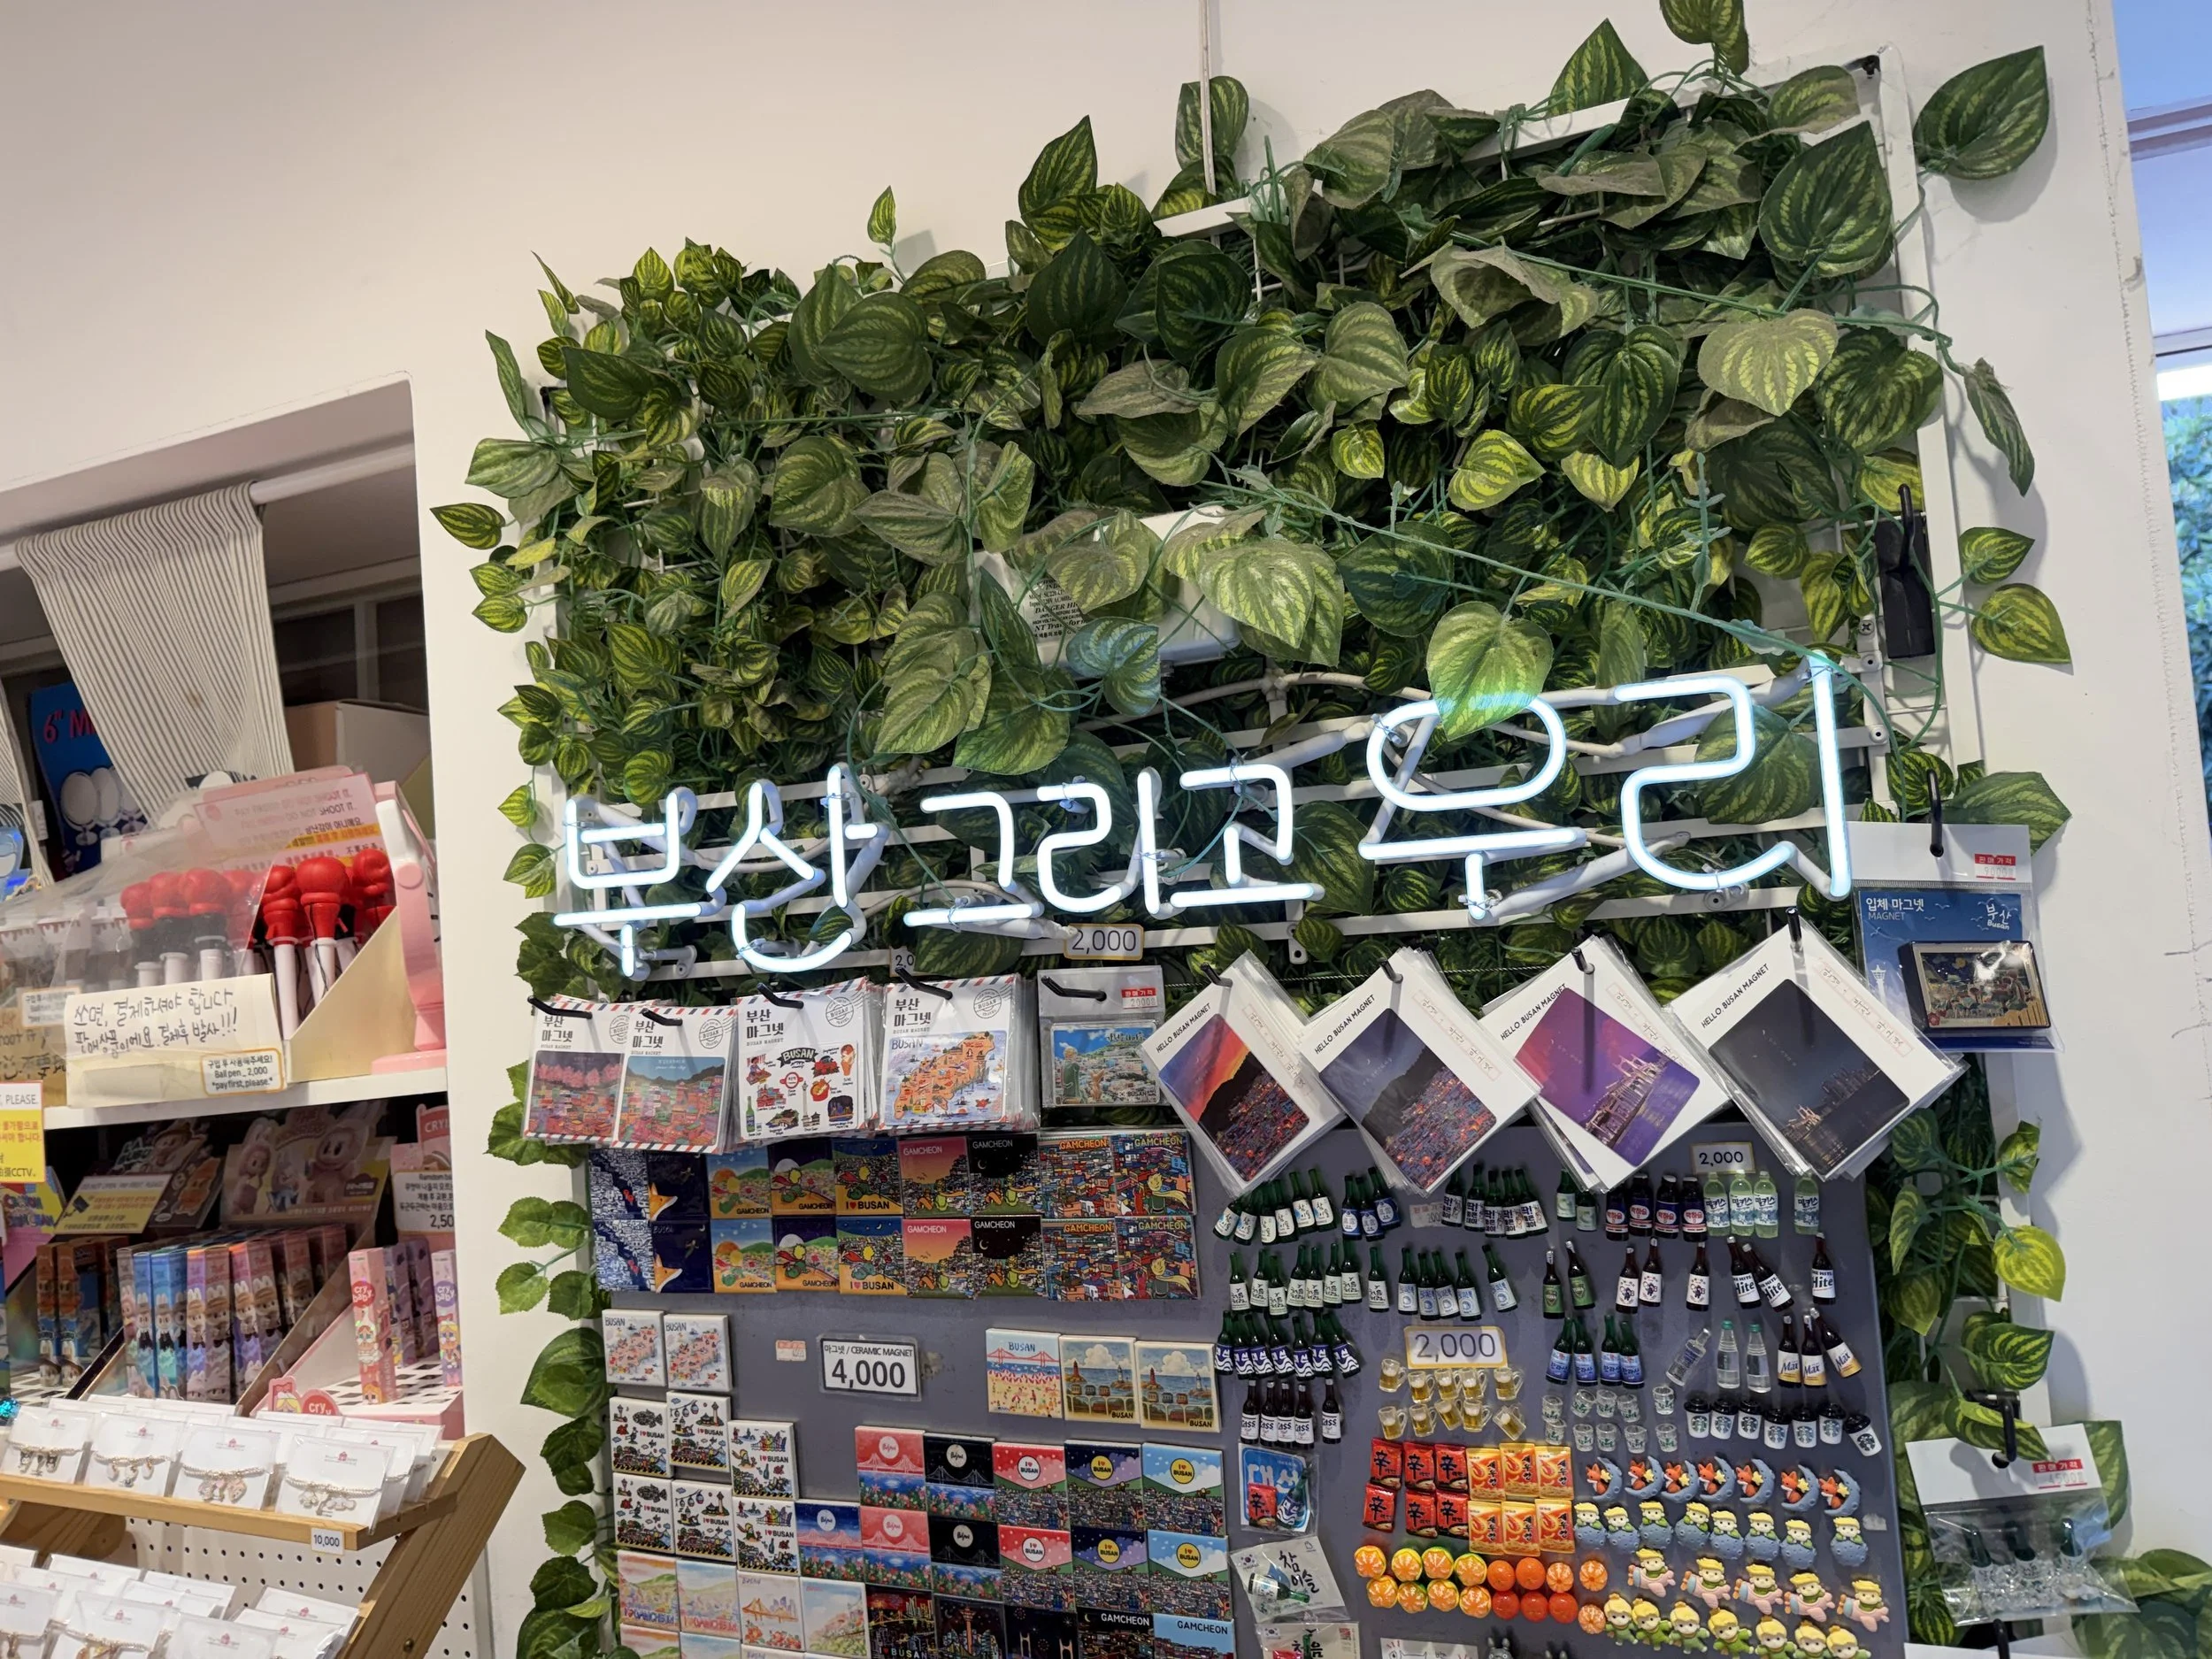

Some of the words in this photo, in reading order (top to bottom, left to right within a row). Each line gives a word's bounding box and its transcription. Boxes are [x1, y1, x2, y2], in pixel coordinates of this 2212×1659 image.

[553, 764, 879, 978] 부산
[903, 763, 1317, 926] 그리고
[1358, 649, 1851, 921] 우리
[1978, 856, 2013, 865] 판매가격
[1866, 897, 1888, 912] 입체
[1892, 897, 1924, 912] 마그넷
[1868, 911, 1906, 921] MAGNET
[1986, 902, 2012, 926] 부산
[1986, 919, 2010, 930] Busan
[1071, 929, 1138, 955] 2,000
[1722, 988, 1743, 1010] BUSAN
[1743, 963, 1770, 992] MAGNET
[895, 997, 921, 1011] 부산
[1521, 1003, 1541, 1024] BUSAN
[1540, 983, 1567, 1010] MAGNET
[543, 1015, 565, 1028] 부산
[746, 1009, 772, 1023] 부산
[894, 1011, 932, 1026] 마그넷
[1173, 1021, 1190, 1038] BUSAN
[1190, 1002, 1211, 1025] MAGNET
[1333, 1017, 1353, 1036] BUSAN
[1353, 994, 1376, 1019] MAGNET
[634, 1020, 655, 1033] 부산
[746, 1023, 784, 1039] 마그넷
[541, 1029, 573, 1042] 마그넷
[632, 1035, 664, 1048] 마그넷
[892, 1039, 924, 1050] BUSAN
[782, 1048, 815, 1062] BUSAN
[214, 1070, 227, 1079] Ball
[248, 1066, 268, 1077] 2,000
[5, 1094, 39, 1105] PLEASE.
[972, 1139, 1013, 1148] GAMCHEON
[1059, 1138, 1108, 1150] GAMCHEON
[1134, 1137, 1183, 1148] GAMCHEON
[903, 1146, 942, 1156] GAMCHEON
[1699, 1150, 1744, 1165] 2,000
[798, 1202, 833, 1210] GAMCHEON
[857, 1201, 890, 1210] BUSAN
[430, 1214, 454, 1229] 2,50
[974, 1220, 1016, 1230] GAMCHEON
[1064, 1223, 1112, 1233] GAMCHEON
[1138, 1221, 1187, 1232] GAMCHEON
[907, 1225, 947, 1234] GAMCHEON
[862, 1281, 895, 1291] BUSAN
[605, 1317, 626, 1326] BUSAN
[665, 1322, 687, 1332] BUSAN
[824, 1344, 846, 1356] 마그넷
[851, 1346, 881, 1356] CERAMIC
[882, 1347, 913, 1357] MAGNET
[1009, 1341, 1035, 1352] BUSAN
[1414, 1333, 1496, 1363] 2,000
[1834, 1352, 1850, 1368] Max
[832, 1358, 906, 1389] 4,000
[1781, 1361, 1799, 1374] Max
[1804, 1363, 1820, 1375] Max
[1373, 1449, 1391, 1475] 辛
[1407, 1454, 1425, 1479] 辛
[1440, 1454, 1457, 1479] 辛
[2037, 1462, 2079, 1472] 판매가격
[1250, 1492, 1265, 1517] 辛
[1369, 1494, 1386, 1520] 辛
[1407, 1501, 1425, 1525] 辛
[1440, 1499, 1457, 1524] 辛
[314, 1534, 340, 1547] 10,000
[1279, 1550, 1301, 1573] 참
[1291, 1569, 1320, 1594] 이슬
[1101, 1613, 1149, 1626] GAMCHEON
[1177, 1620, 1228, 1634] GAMCHEON
[891, 1647, 927, 1659] BUSAN
